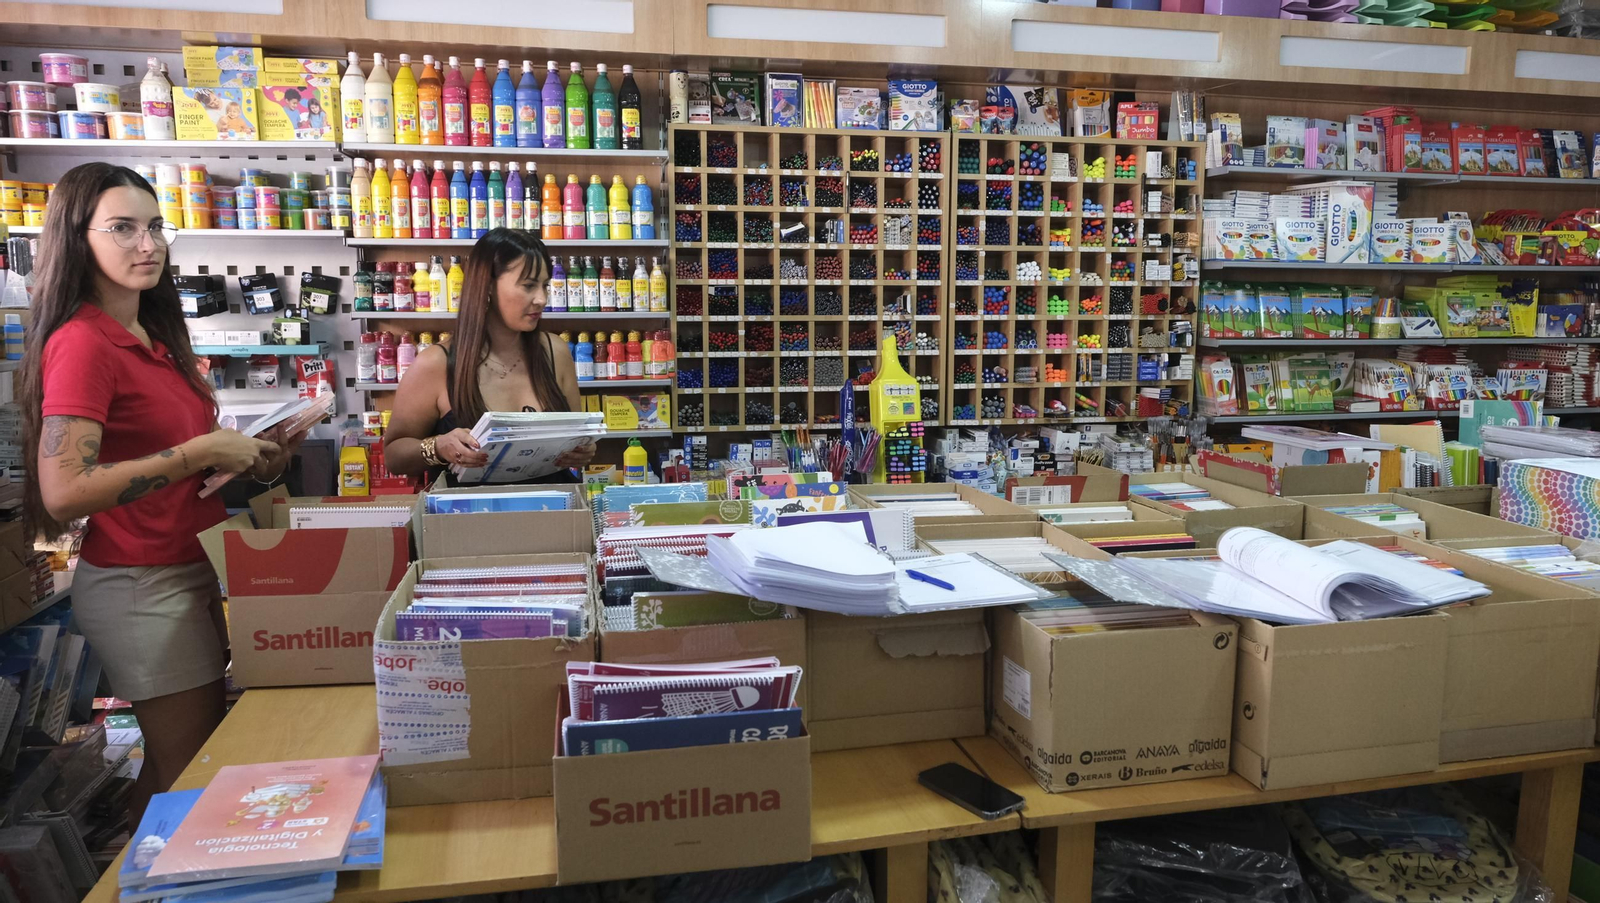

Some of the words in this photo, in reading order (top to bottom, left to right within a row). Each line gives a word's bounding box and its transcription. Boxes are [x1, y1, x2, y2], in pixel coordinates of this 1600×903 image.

[1331, 204, 1341, 246] GIOTTO
[1375, 222, 1404, 230] GIOTTO
[304, 362, 323, 372] Pritt
[1213, 368, 1232, 376] CARIOCA
[1245, 364, 1270, 372] CARIOCA
[1380, 377, 1406, 385] CARIOCA
[1435, 375, 1465, 383] CARIOCA
[250, 577, 294, 586] Santillana
[253, 625, 376, 652] Santillan
[374, 658, 417, 671] Jobe
[428, 680, 464, 694] obe
[1189, 738, 1226, 754] algaida
[1037, 747, 1072, 765] algaida
[1094, 749, 1126, 757] BARCANOVA
[1136, 744, 1180, 760] ANAYA
[1094, 755, 1126, 763] EDITORIAL
[1195, 761, 1225, 771] edelsa
[1081, 772, 1112, 781] XERAIS
[1136, 766, 1167, 777] Bruño
[589, 787, 781, 827] Santillana
[312, 828, 323, 838] y
[195, 831, 308, 846] Digitalización
[208, 842, 299, 856] Tecnología
